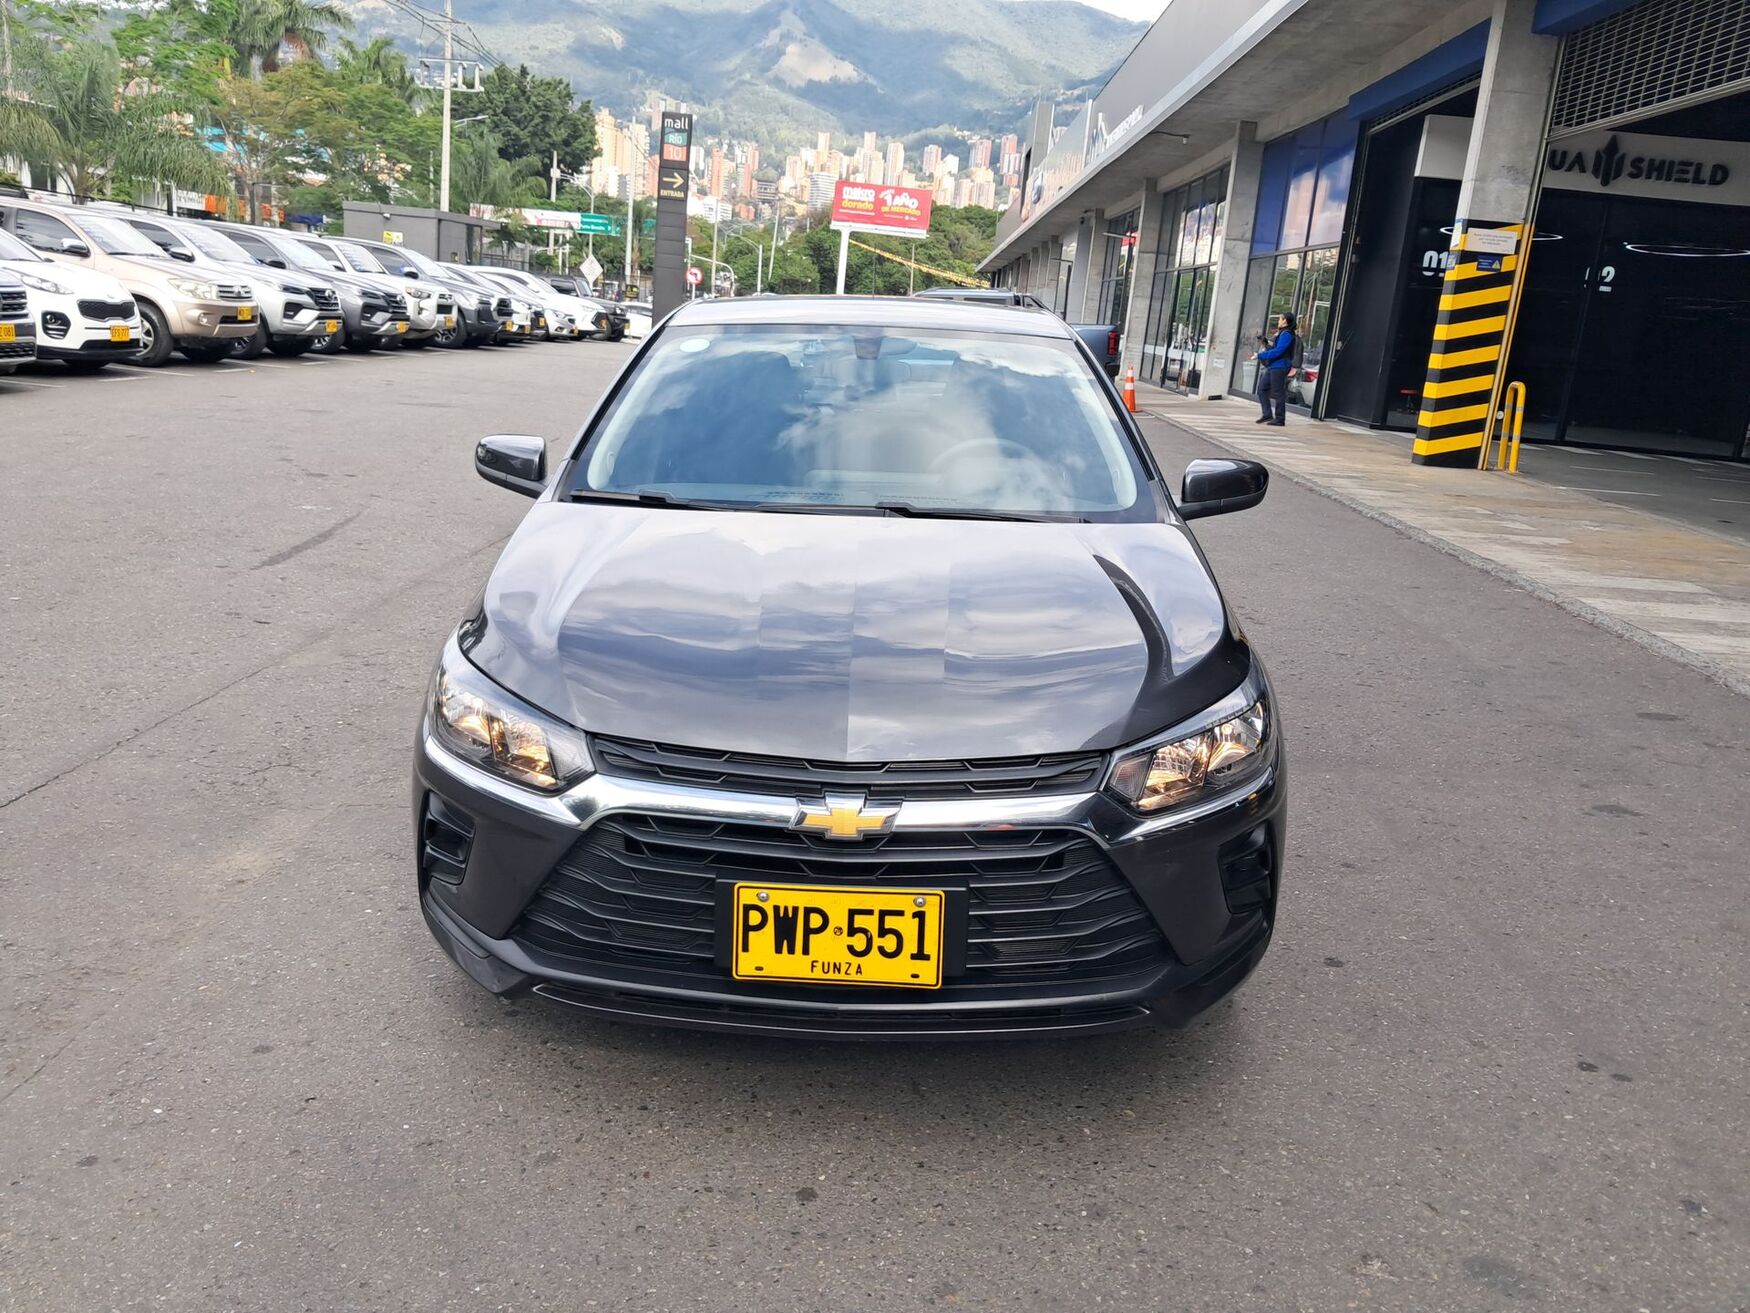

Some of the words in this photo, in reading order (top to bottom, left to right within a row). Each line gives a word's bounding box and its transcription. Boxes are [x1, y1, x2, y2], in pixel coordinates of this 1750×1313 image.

[664, 116, 689, 130] mall
[668, 133, 683, 144] RÍO
[669, 147, 682, 160] 10
[1626, 156, 1730, 187] SHIELD
[660, 189, 685, 199] ENTRADA
[893, 192, 919, 209] AÑO
[841, 199, 875, 210] dorado
[741, 903, 830, 956] PWP
[845, 908, 932, 962] 551
[810, 960, 864, 976] FUNZA
